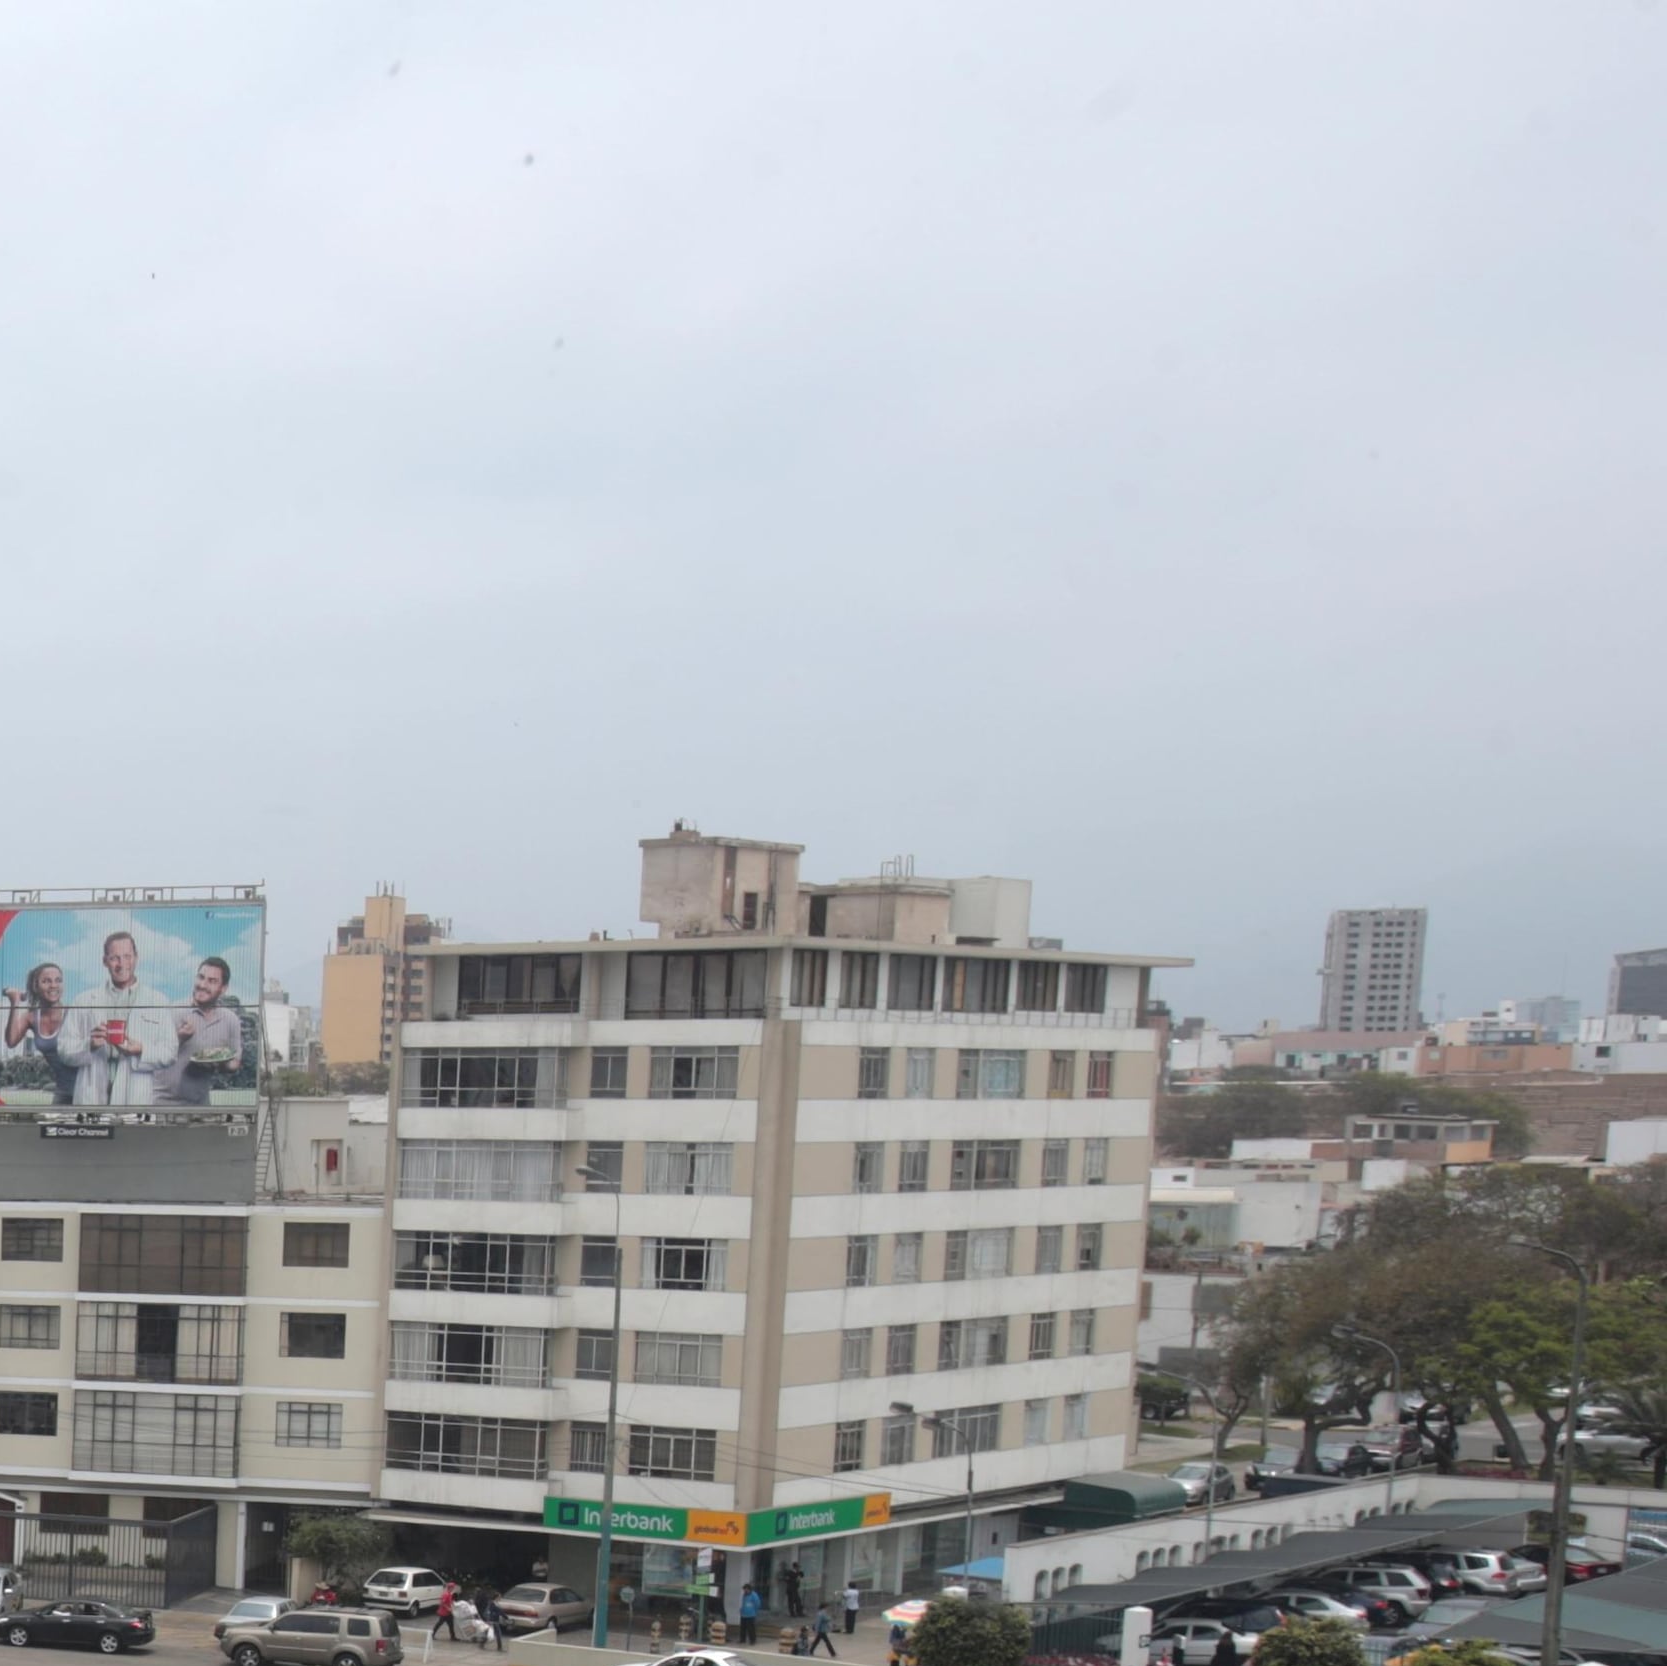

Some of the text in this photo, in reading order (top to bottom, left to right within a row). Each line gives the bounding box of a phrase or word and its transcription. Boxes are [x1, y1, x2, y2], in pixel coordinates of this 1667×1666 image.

[57, 1126, 109, 1137] Clear Channel
[584, 1506, 673, 1534] Inerbank
[788, 1507, 835, 1531] Interbank
